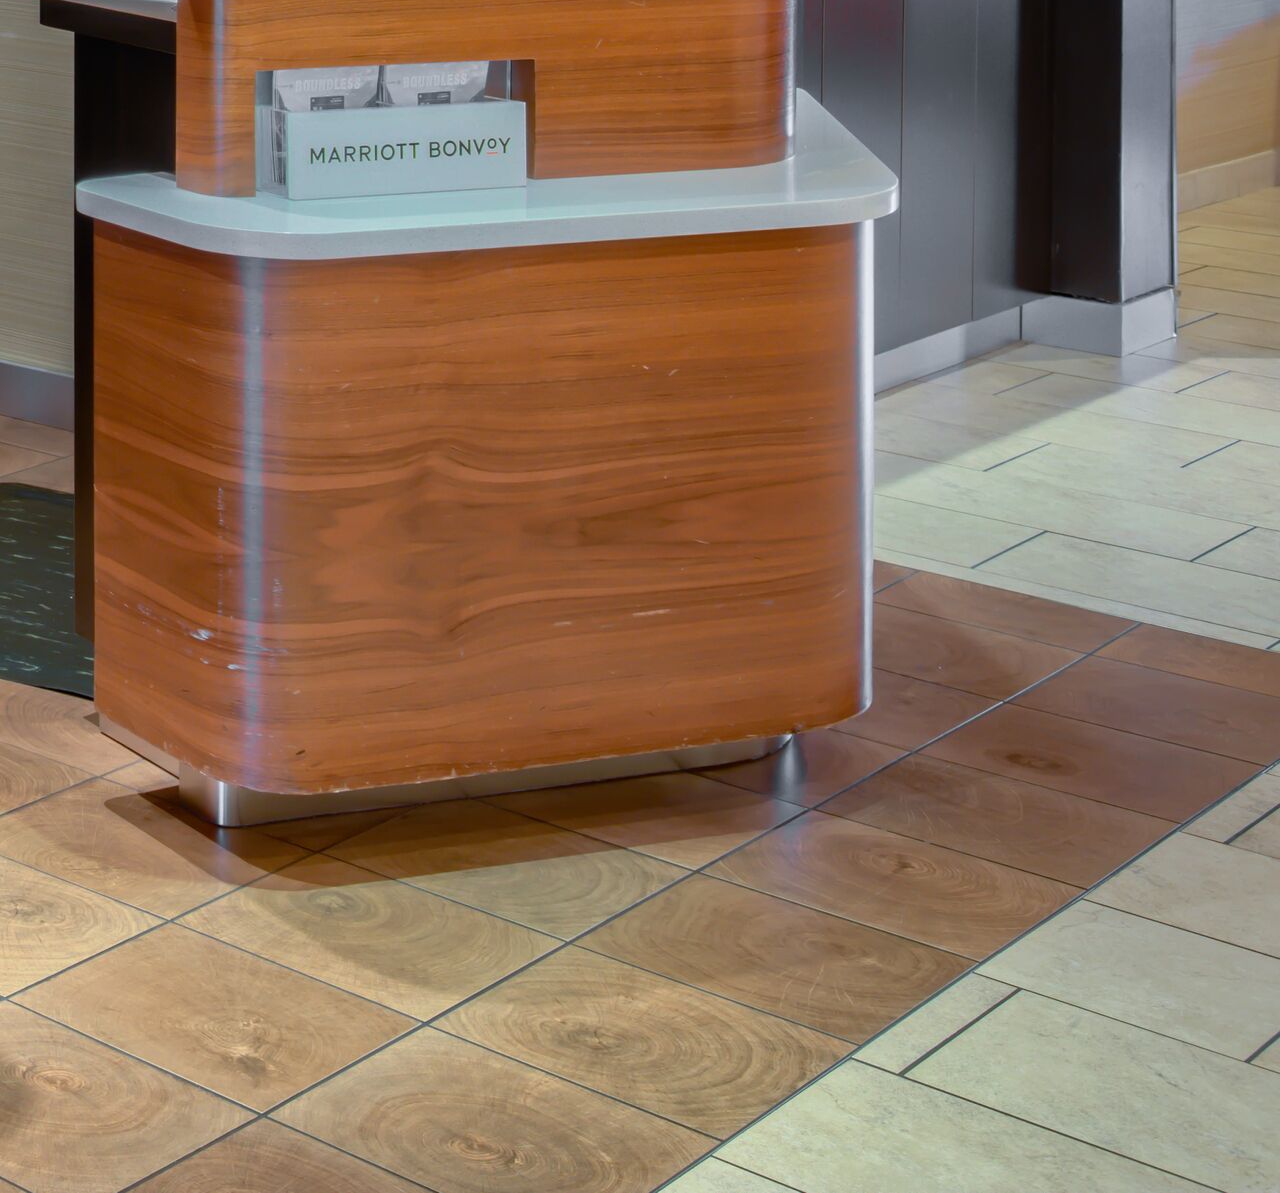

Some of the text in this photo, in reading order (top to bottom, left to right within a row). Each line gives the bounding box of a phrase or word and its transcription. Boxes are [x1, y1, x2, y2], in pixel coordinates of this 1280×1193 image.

[295, 77, 361, 92] BOUNDLESS
[402, 73, 468, 88] BOUNDLESS
[310, 142, 419, 164] MARRIOTT
